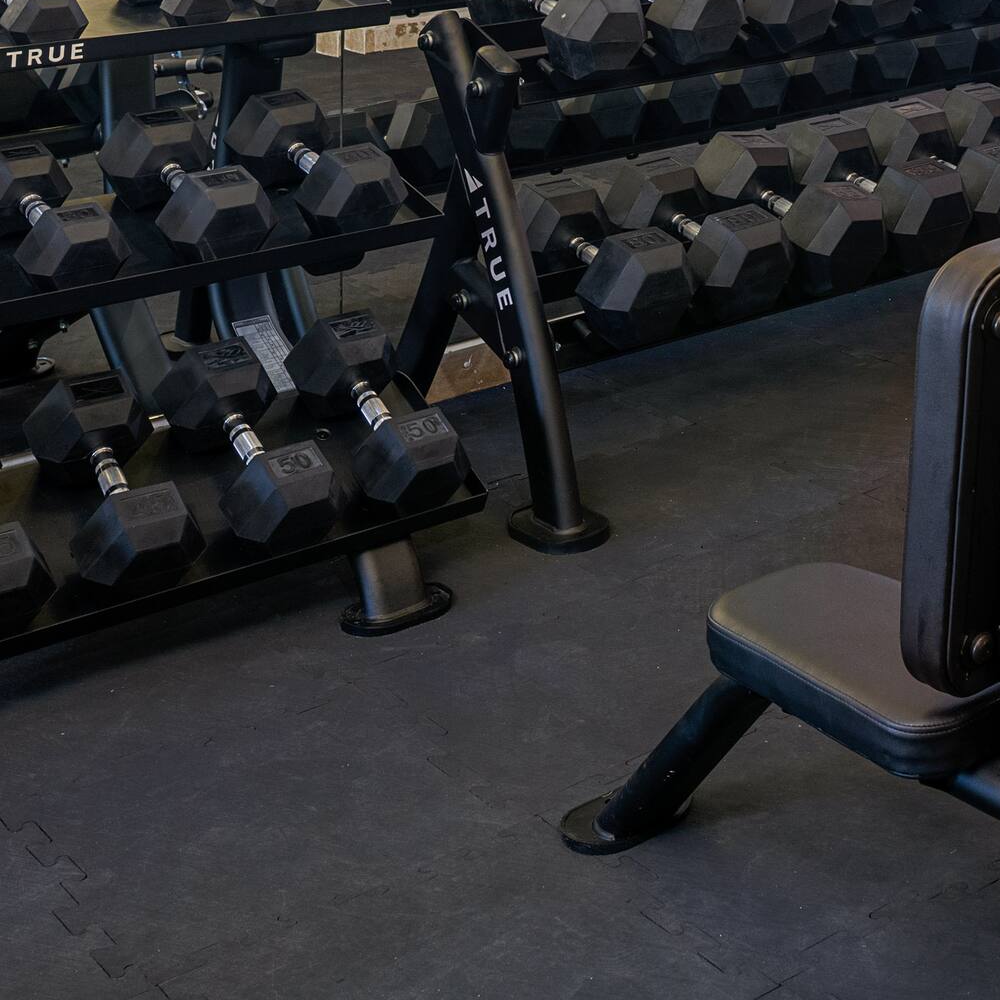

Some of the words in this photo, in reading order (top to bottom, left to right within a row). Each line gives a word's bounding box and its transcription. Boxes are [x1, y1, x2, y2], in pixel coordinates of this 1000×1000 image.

[6, 42, 85, 68] TRUE
[475, 197, 514, 311] TRUE
[406, 419, 439, 440] 50
[276, 453, 312, 475] 50
